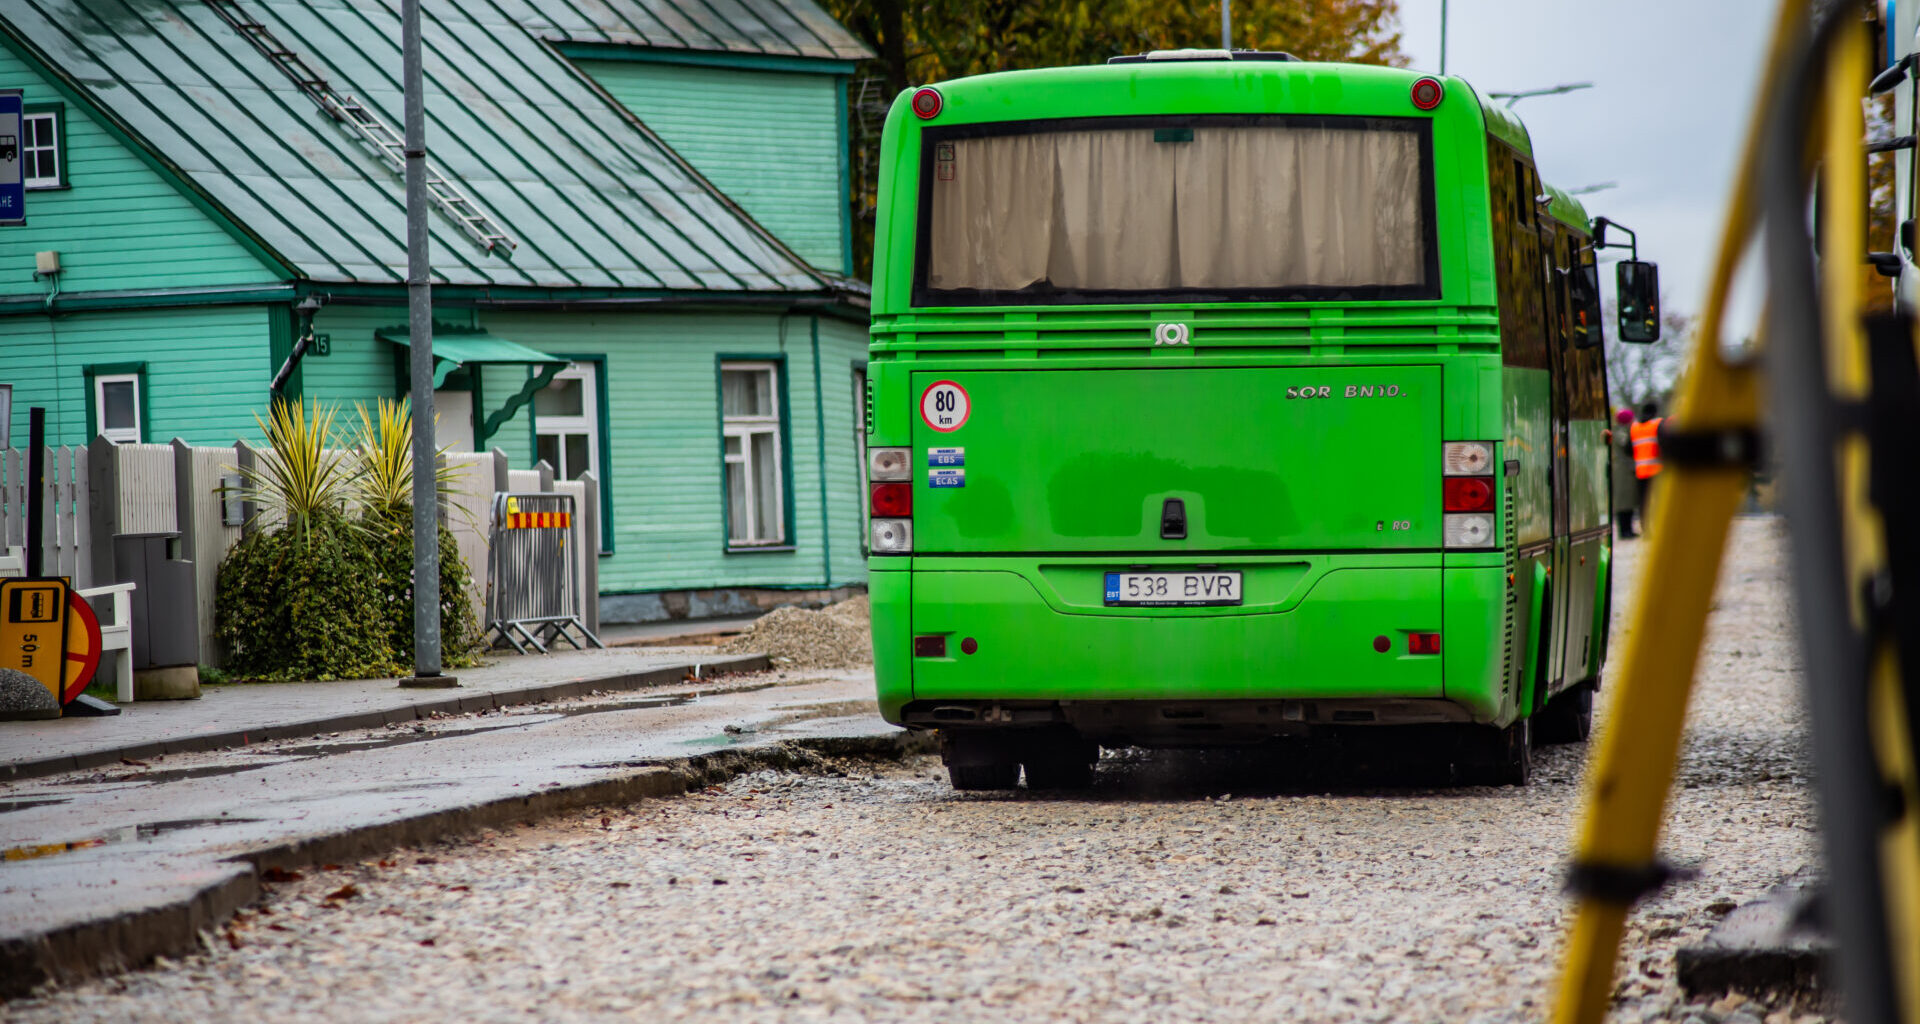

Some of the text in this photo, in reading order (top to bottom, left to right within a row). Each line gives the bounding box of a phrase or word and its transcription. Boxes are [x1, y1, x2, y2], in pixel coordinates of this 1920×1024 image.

[315, 336, 328, 353] 15
[1286, 386, 1331, 399] SOR
[935, 390, 955, 412] 80
[939, 414, 952, 425] km
[936, 477, 958, 485] ECAS
[1128, 576, 1233, 597] 538 BVR
